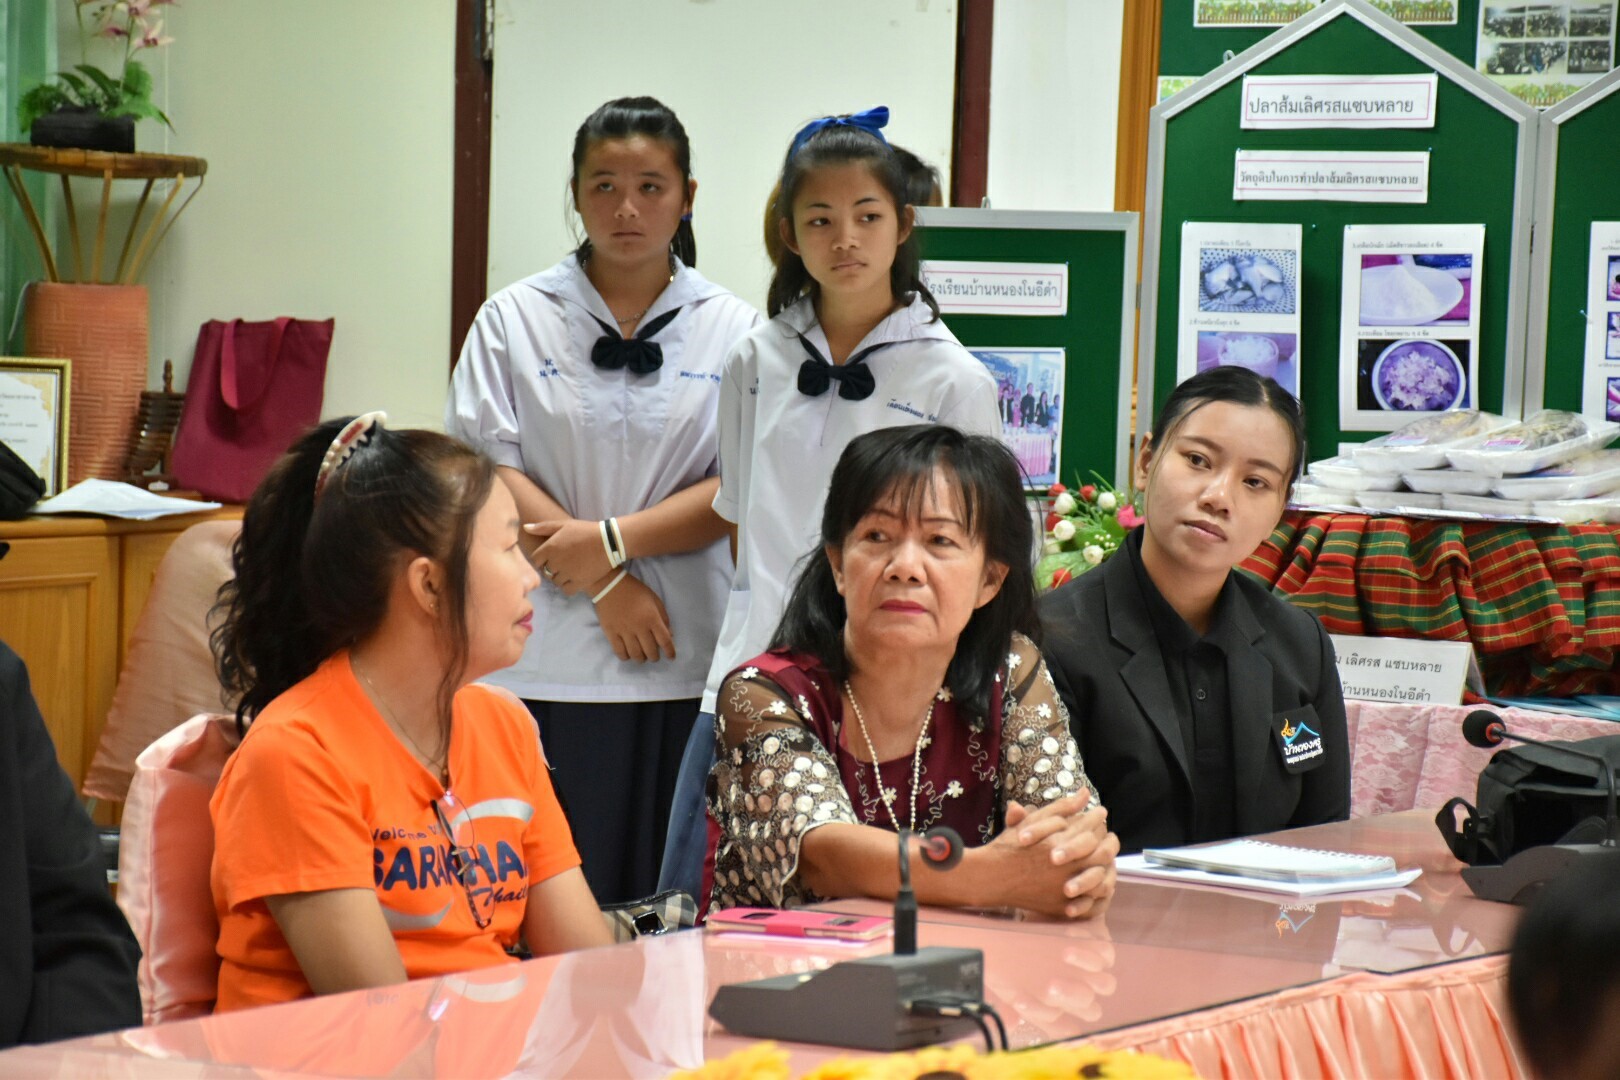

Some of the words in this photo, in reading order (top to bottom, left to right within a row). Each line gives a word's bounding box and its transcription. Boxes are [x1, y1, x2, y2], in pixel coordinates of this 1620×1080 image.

[1250, 95, 1414, 114] ปลาส้มเลิศรสแซบหลาย
[373, 840, 529, 892] SARAKHA
